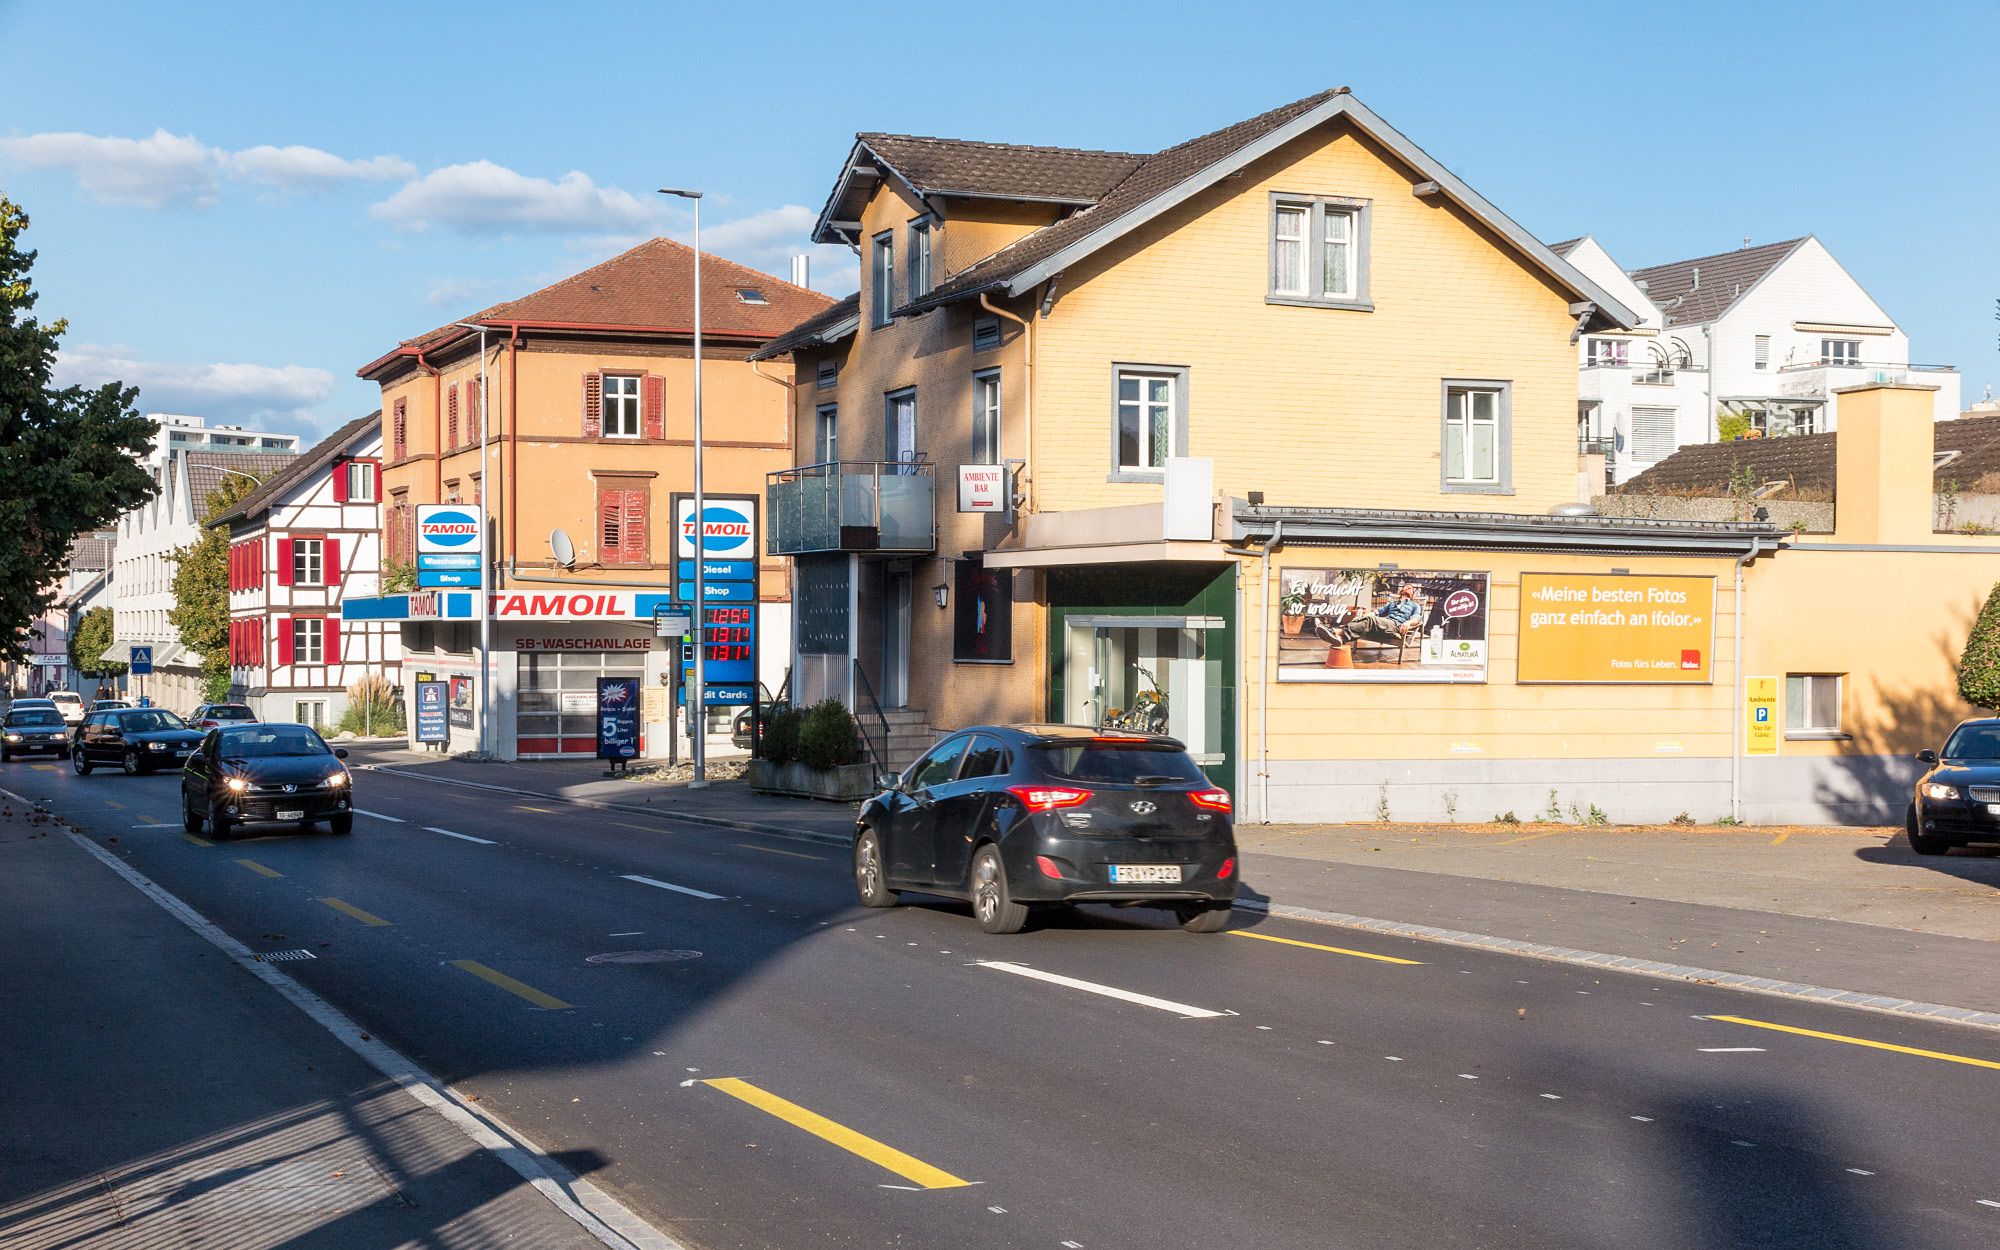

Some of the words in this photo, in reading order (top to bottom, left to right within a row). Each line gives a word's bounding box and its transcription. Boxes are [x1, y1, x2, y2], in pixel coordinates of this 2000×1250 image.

[964, 472, 999, 481] AMBIENTE
[974, 484, 988, 492] BAR
[421, 524, 478, 534] TAMOIL
[424, 557, 476, 566] Waschanlage
[440, 574, 461, 582] Shop
[704, 586, 730, 596] Shop
[1290, 580, 1308, 596] Es
[1310, 576, 1364, 596] braucht
[1532, 586, 1588, 602] «Meine
[1592, 586, 1642, 602] besten
[1648, 588, 1686, 604] Fotos
[410, 594, 436, 616] TAMOIL
[489, 594, 626, 616] TAMOIL
[1288, 602, 1306, 615] so
[1308, 600, 1352, 624] wenig.
[1530, 612, 1566, 628] ganz
[1570, 610, 1625, 626] einfach
[1630, 614, 1648, 626] an
[1652, 611, 1702, 627] ifolor.»
[516, 638, 650, 649] SB-WASCHANLAGE
[1611, 660, 1632, 668] Fotos
[1634, 660, 1650, 668] fürs
[1651, 660, 1678, 668] Leben.
[718, 690, 748, 698] Cards
[1758, 709, 1766, 720] P
[602, 718, 616, 736] 5
[604, 738, 628, 746] billiger
[1118, 868, 1134, 880] FR
